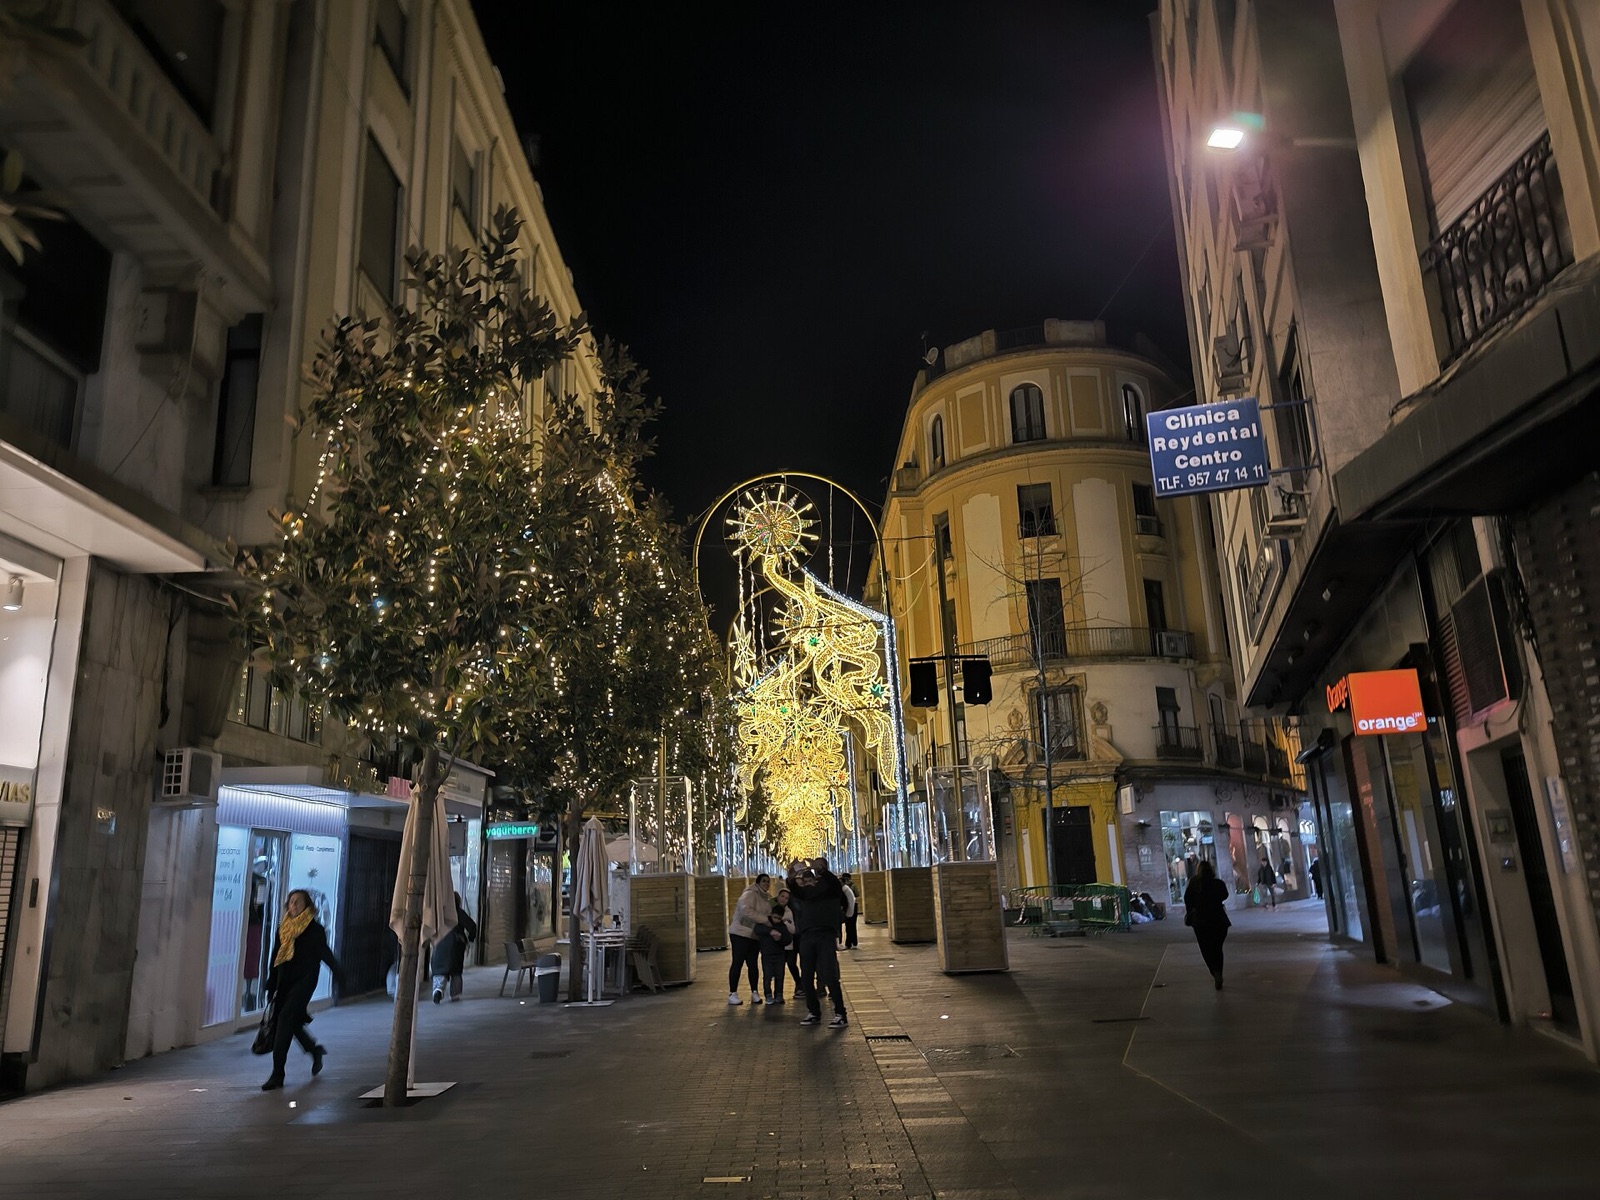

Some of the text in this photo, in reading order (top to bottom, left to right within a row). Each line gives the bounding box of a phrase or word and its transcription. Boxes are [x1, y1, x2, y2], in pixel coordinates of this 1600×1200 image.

[1166, 409, 1240, 430] Clínica
[1153, 423, 1258, 452] Reydental
[1175, 450, 1242, 469] Centro
[1159, 464, 1264, 490] TLF. 957 47 14 11
[1358, 716, 1418, 732] orange
